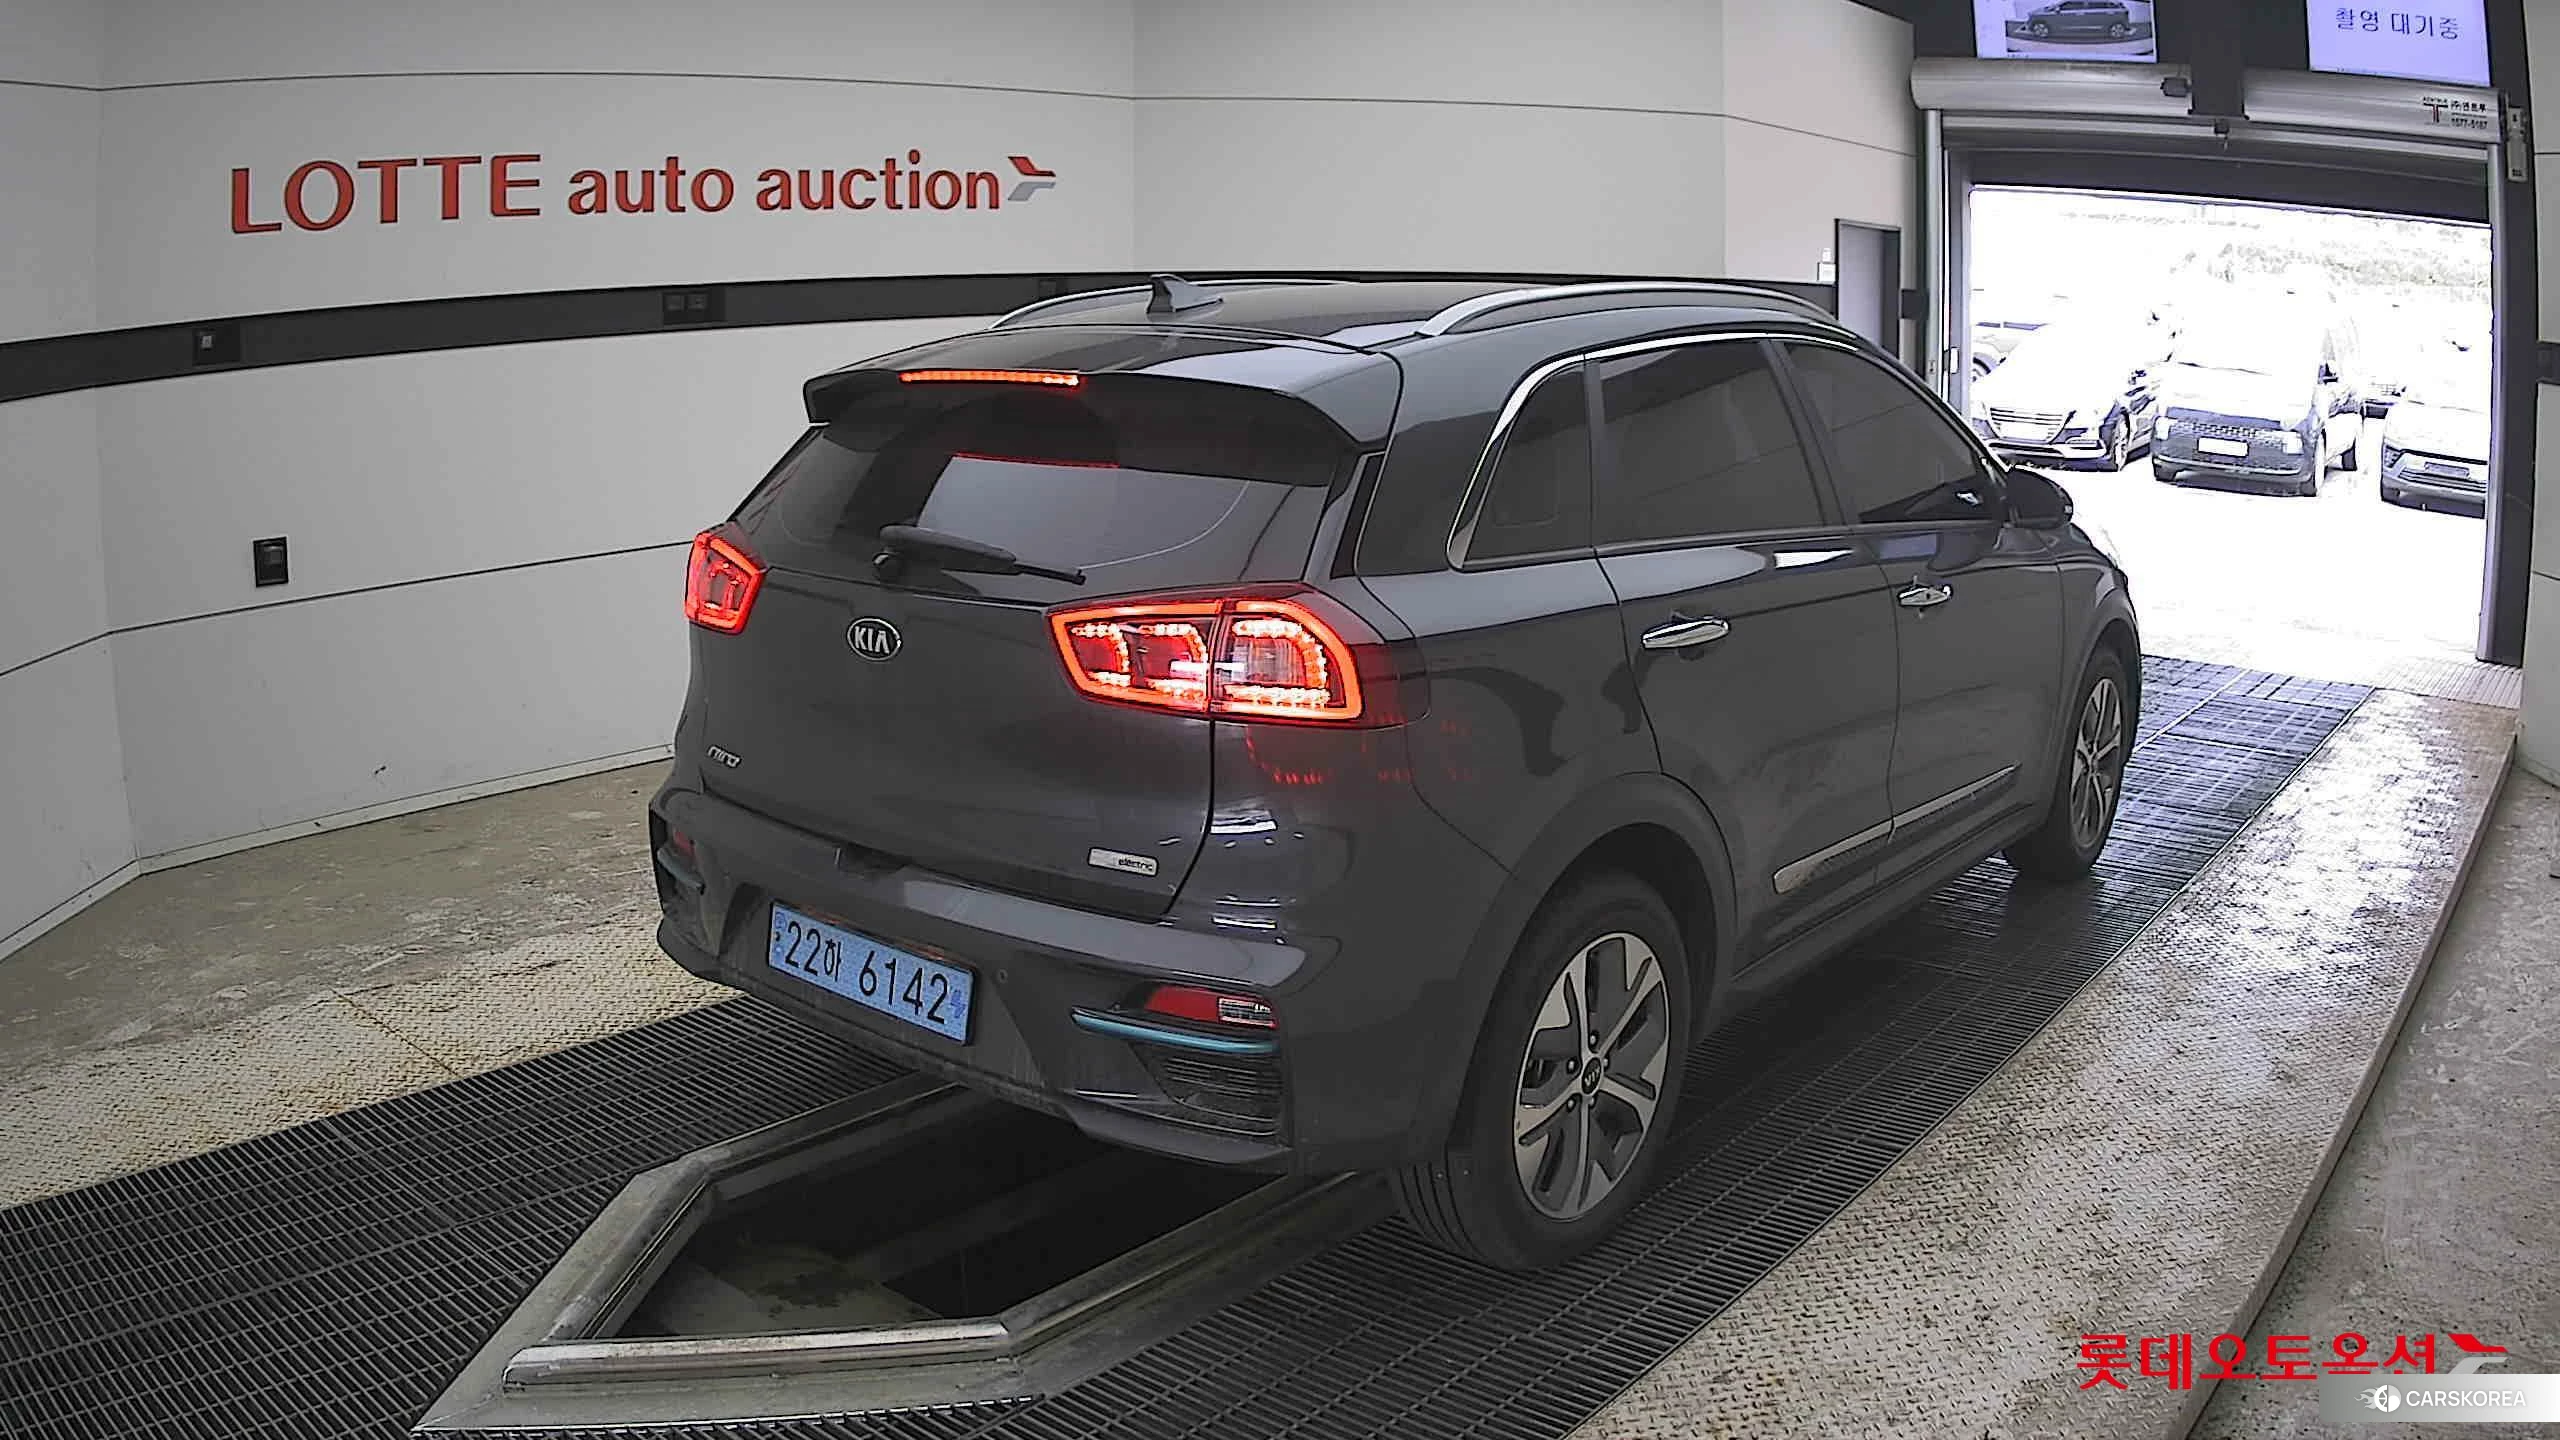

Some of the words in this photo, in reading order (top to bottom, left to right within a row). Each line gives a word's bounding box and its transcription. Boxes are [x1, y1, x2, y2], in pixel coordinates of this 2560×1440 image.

[2391, 13, 2458, 40] 대기중
[231, 153, 541, 234] LOTTE
[567, 155, 735, 215] auto
[755, 149, 1000, 211] auction
[854, 625, 890, 654] KIA
[785, 920, 842, 982] 22하
[859, 950, 949, 1025] 6142
